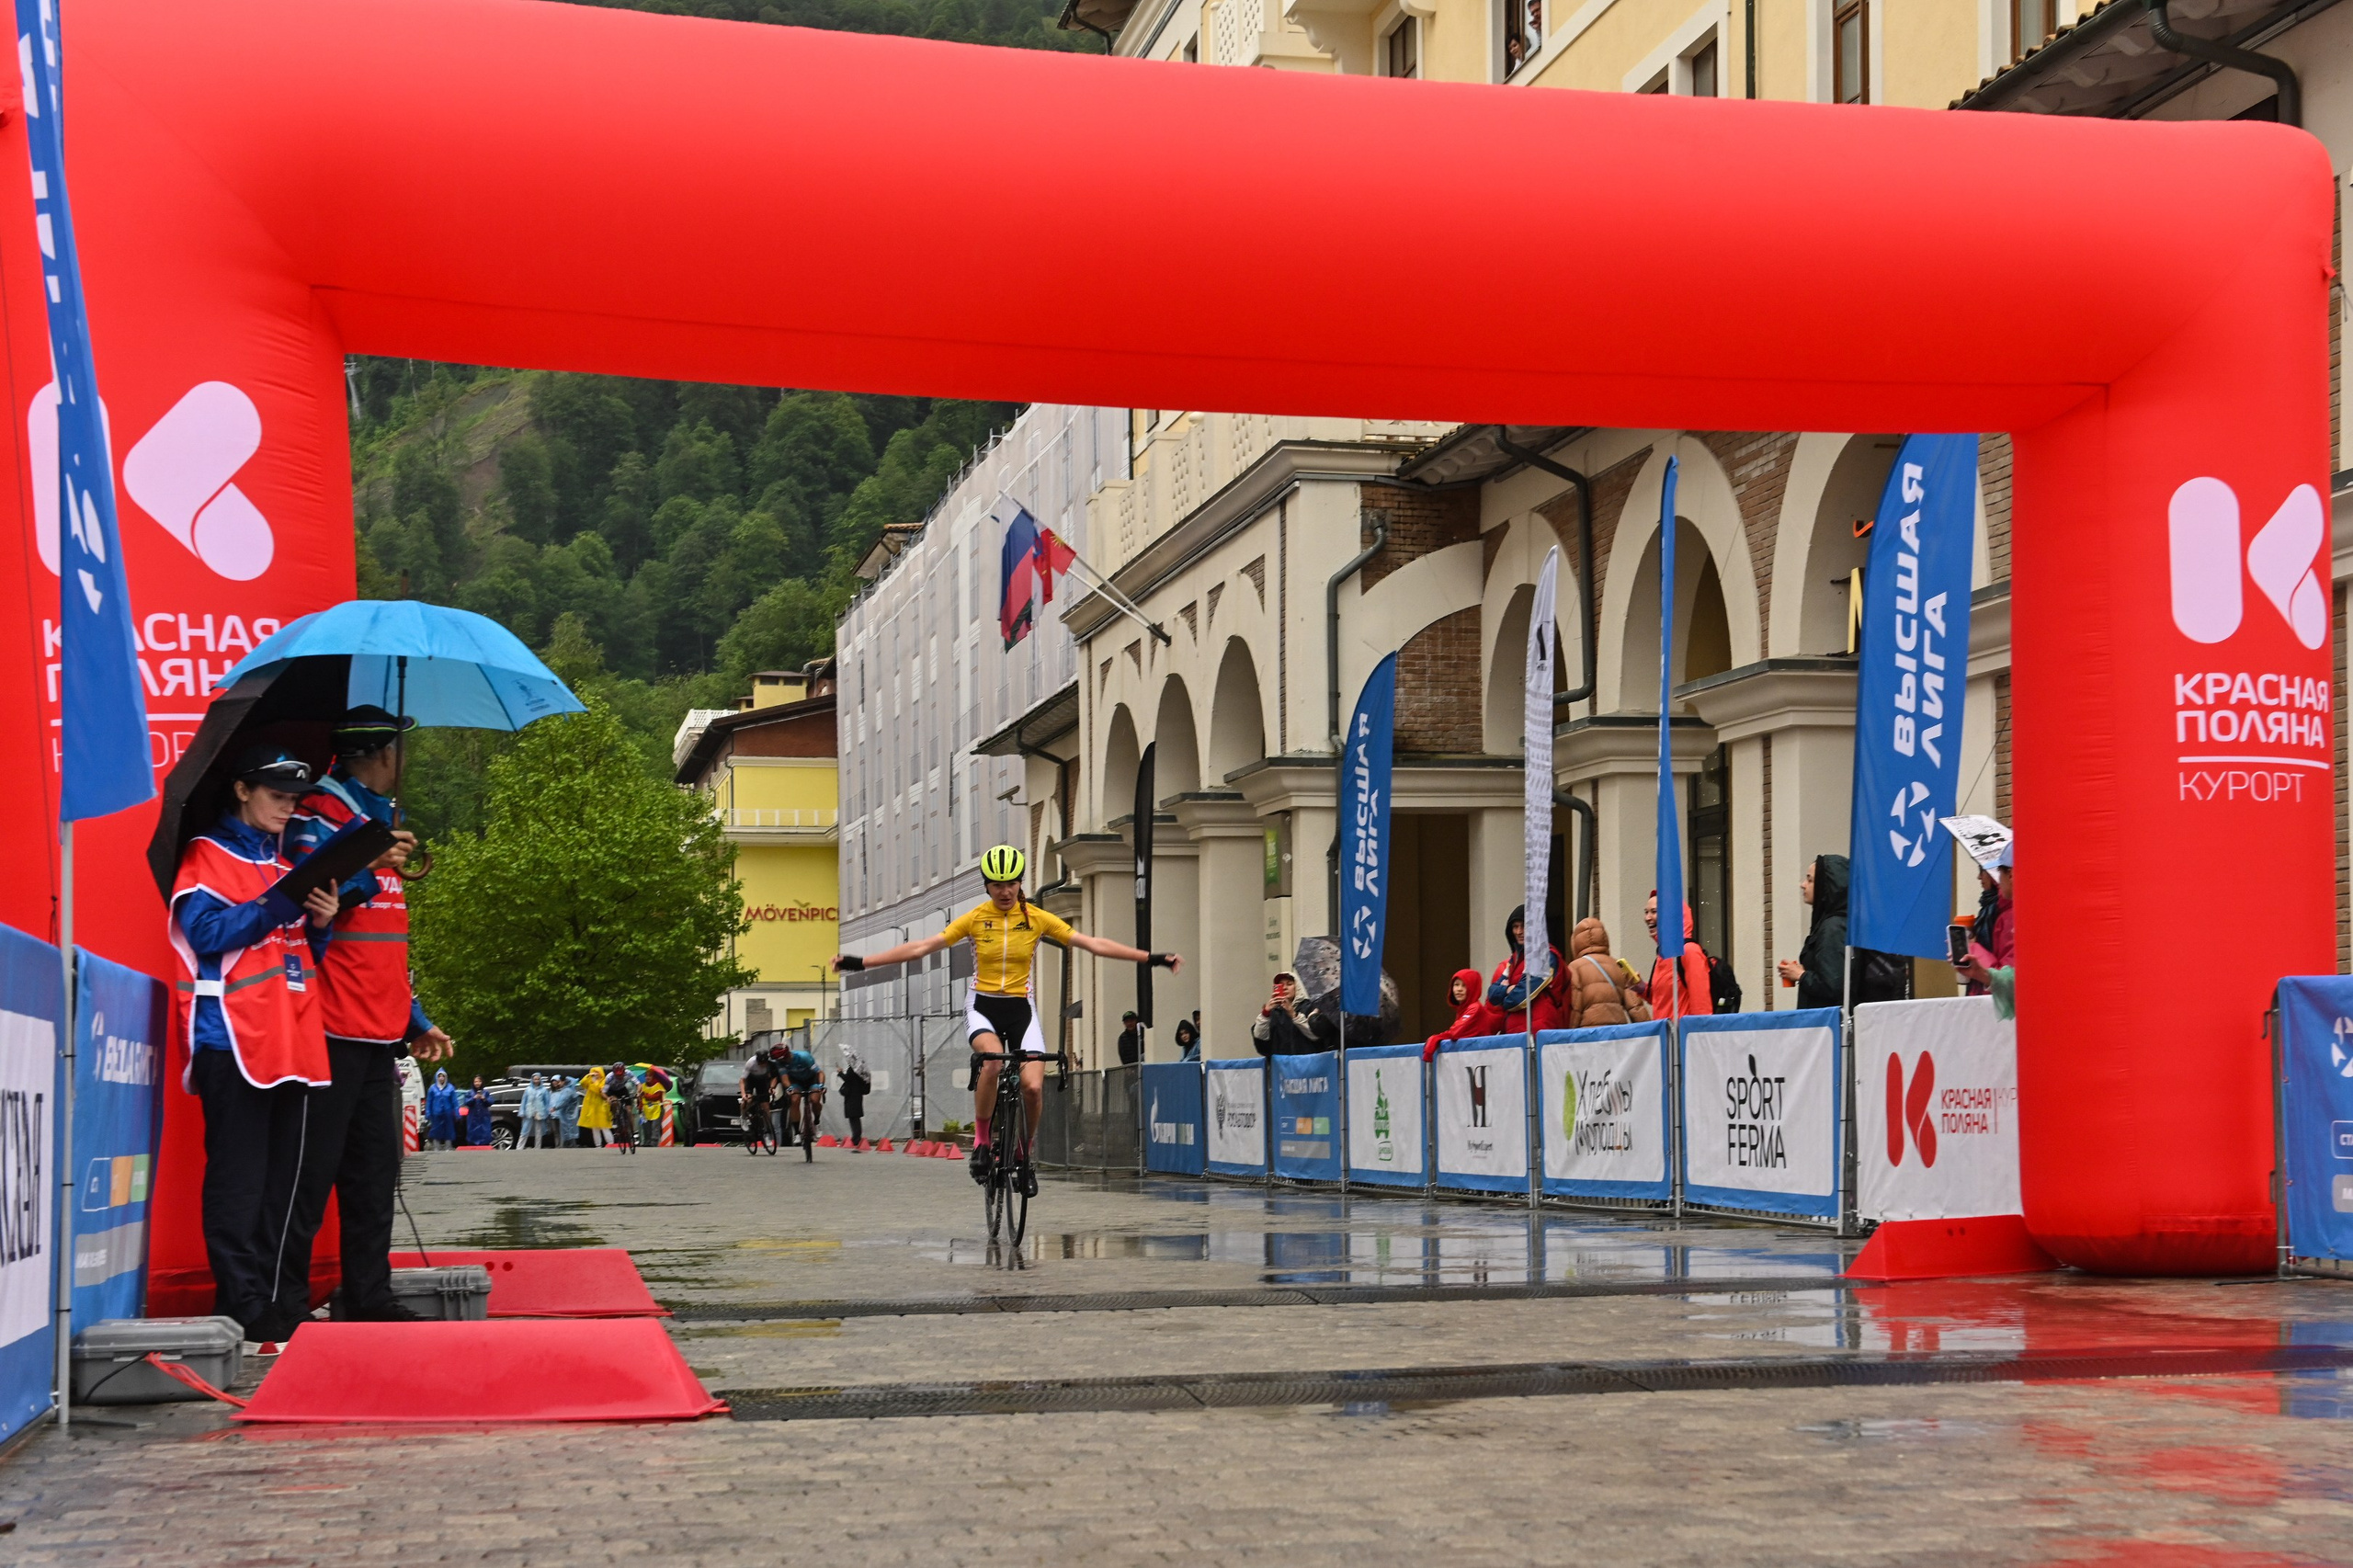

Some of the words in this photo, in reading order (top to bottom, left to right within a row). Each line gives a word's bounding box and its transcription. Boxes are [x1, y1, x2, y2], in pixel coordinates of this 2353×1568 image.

[1893, 461, 1924, 757] ВЫСШАЯ
[43, 612, 280, 657] КСНАЯ
[1922, 591, 1947, 768] ЛИГА
[2175, 673, 2328, 713] КРАСНАЯ
[2177, 710, 2325, 748] ПОЛЯНА
[1355, 712, 1370, 892] ВЫСШАЯ
[2179, 771, 2305, 802] КУРОРТ
[1366, 789, 1379, 897] ЛИГА
[745, 903, 839, 921] MÖVENPIC
[1726, 1076, 1785, 1120] SPORT
[1941, 1088, 1992, 1109] КРАСНАЯ
[1941, 1113, 1989, 1134] ПОЛЯНА
[1728, 1123, 1787, 1169] FERMA
